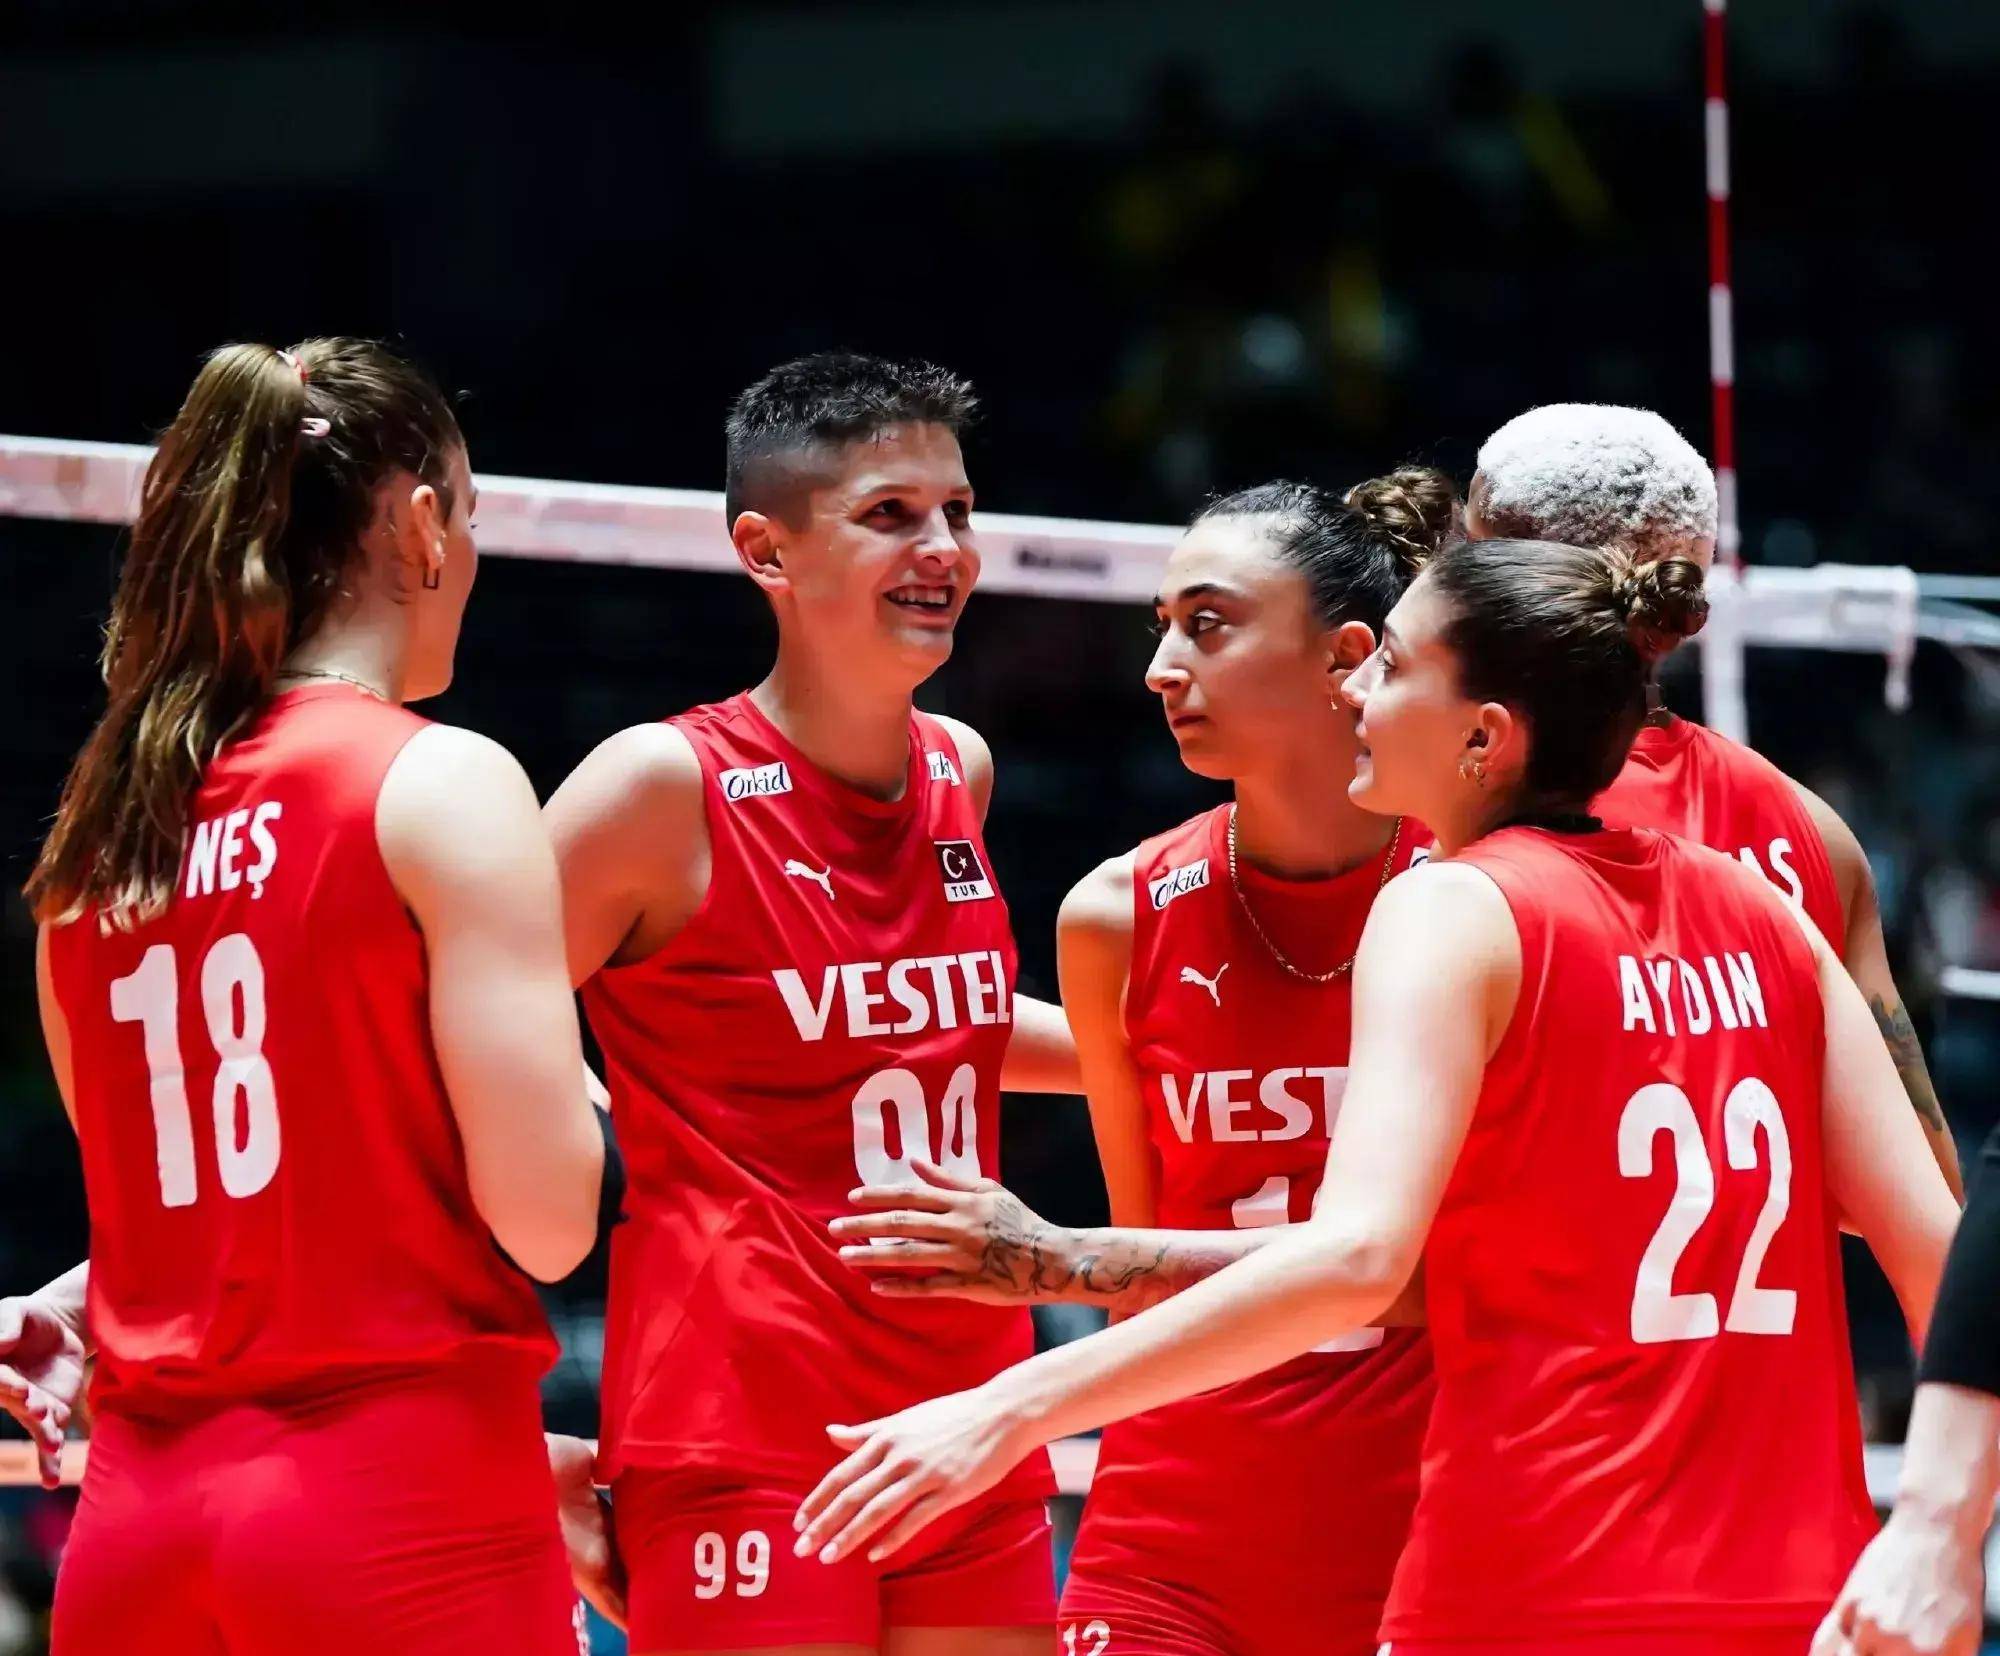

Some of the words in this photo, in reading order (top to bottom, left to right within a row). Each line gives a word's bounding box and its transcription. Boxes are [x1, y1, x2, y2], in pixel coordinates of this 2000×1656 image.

[727, 762, 788, 799] Orkid
[181, 800, 284, 901] NEŞ
[951, 884, 979, 898] TUR
[1154, 863, 1207, 908] Orkid
[771, 951, 1010, 1042] VESTEL
[1618, 951, 1768, 1037] AYDIN
[110, 933, 282, 1208] 18
[1160, 1066, 1349, 1144] VEST
[1617, 1076, 1798, 1344] 22
[694, 1530, 770, 1600] 99
